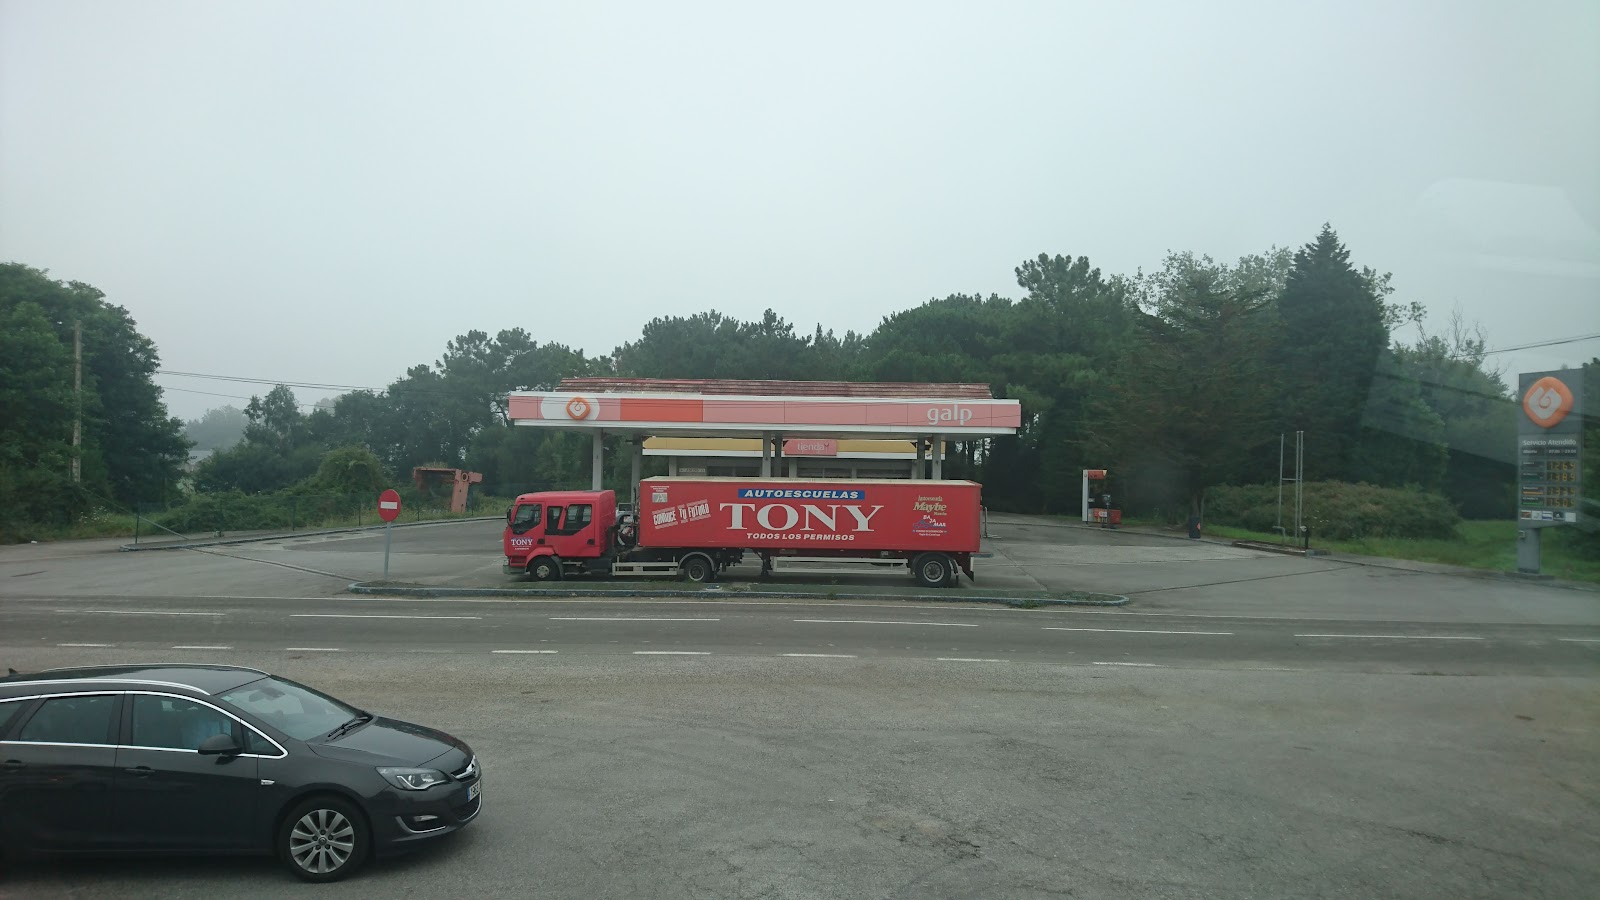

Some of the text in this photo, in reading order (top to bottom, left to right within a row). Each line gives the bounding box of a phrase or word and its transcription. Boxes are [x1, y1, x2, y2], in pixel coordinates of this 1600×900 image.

[927, 404, 973, 426] galp
[797, 442, 825, 451] tienda
[744, 490, 859, 499] AUTOESCUELAS
[913, 502, 947, 513] Maybe
[679, 508, 687, 519] TU
[719, 503, 884, 531] TONY
[746, 532, 780, 540] TODOS
[803, 533, 855, 541] PERMISOS
